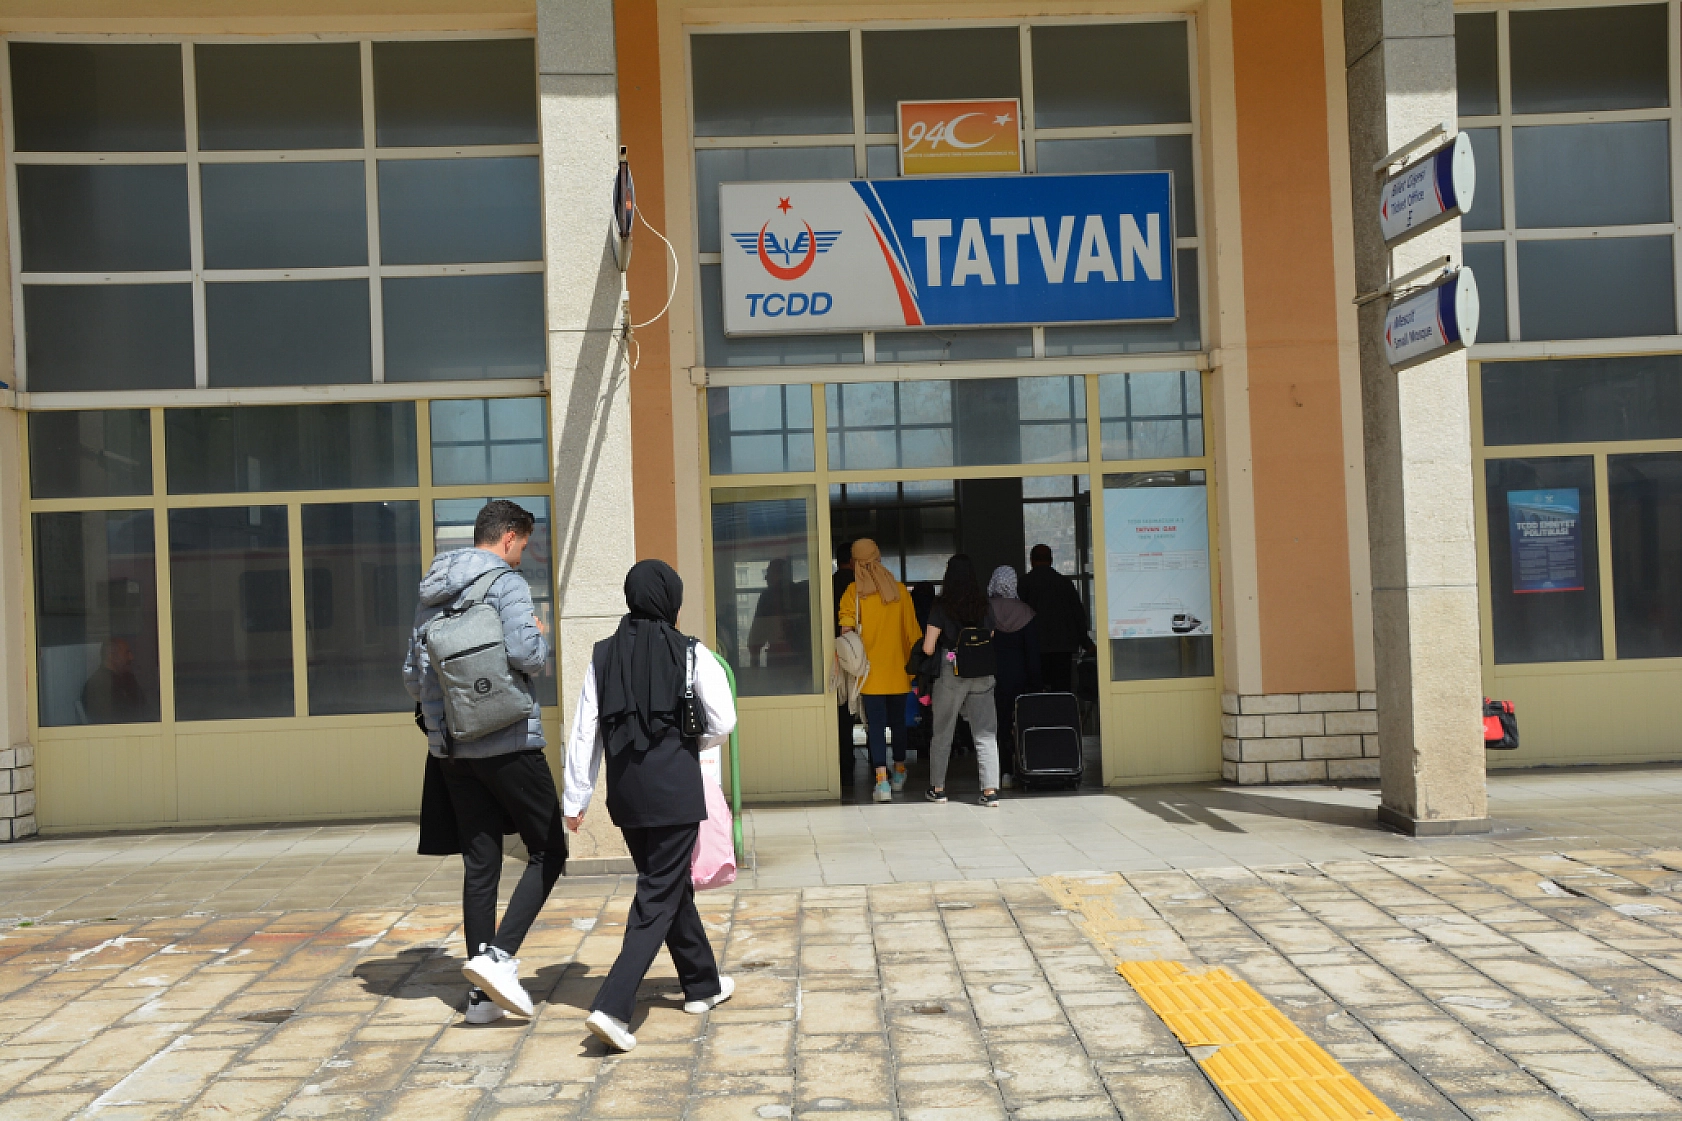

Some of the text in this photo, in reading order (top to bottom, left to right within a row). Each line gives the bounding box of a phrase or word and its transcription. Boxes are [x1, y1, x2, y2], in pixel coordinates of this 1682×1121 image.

[1391, 190, 1425, 214] Ticket Office
[911, 213, 1163, 287] TATVAN
[744, 291, 833, 318] TCDD
[1394, 326, 1433, 349] Small Mosque
